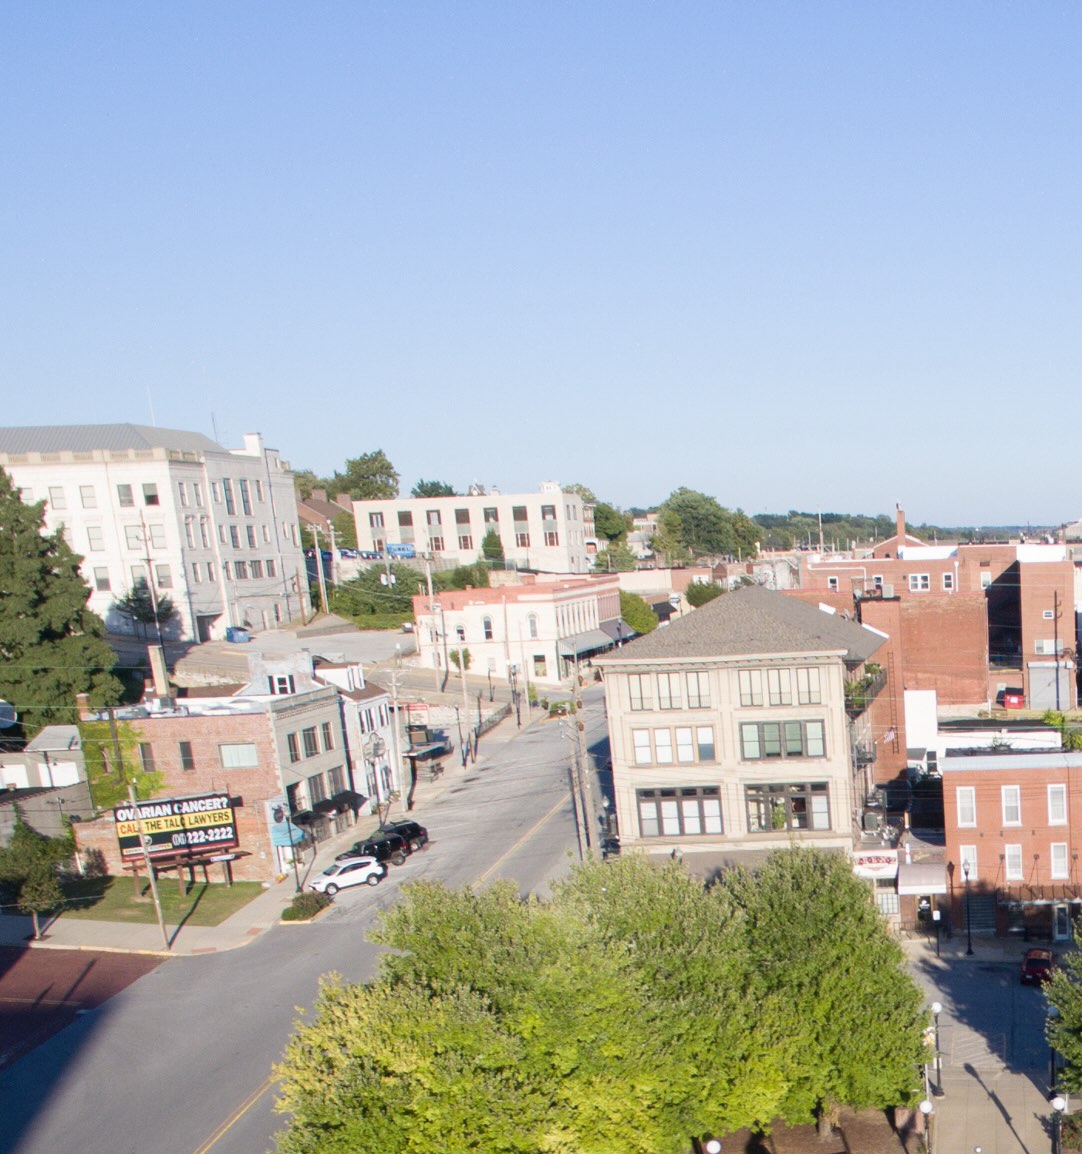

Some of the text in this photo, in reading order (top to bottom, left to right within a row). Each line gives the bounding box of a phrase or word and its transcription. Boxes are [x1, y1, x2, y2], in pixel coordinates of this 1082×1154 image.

[173, 796, 228, 814] CANCER?
[120, 822, 141, 834] CAL
[145, 820, 162, 831] THE
[188, 811, 230, 825] LAWYERS
